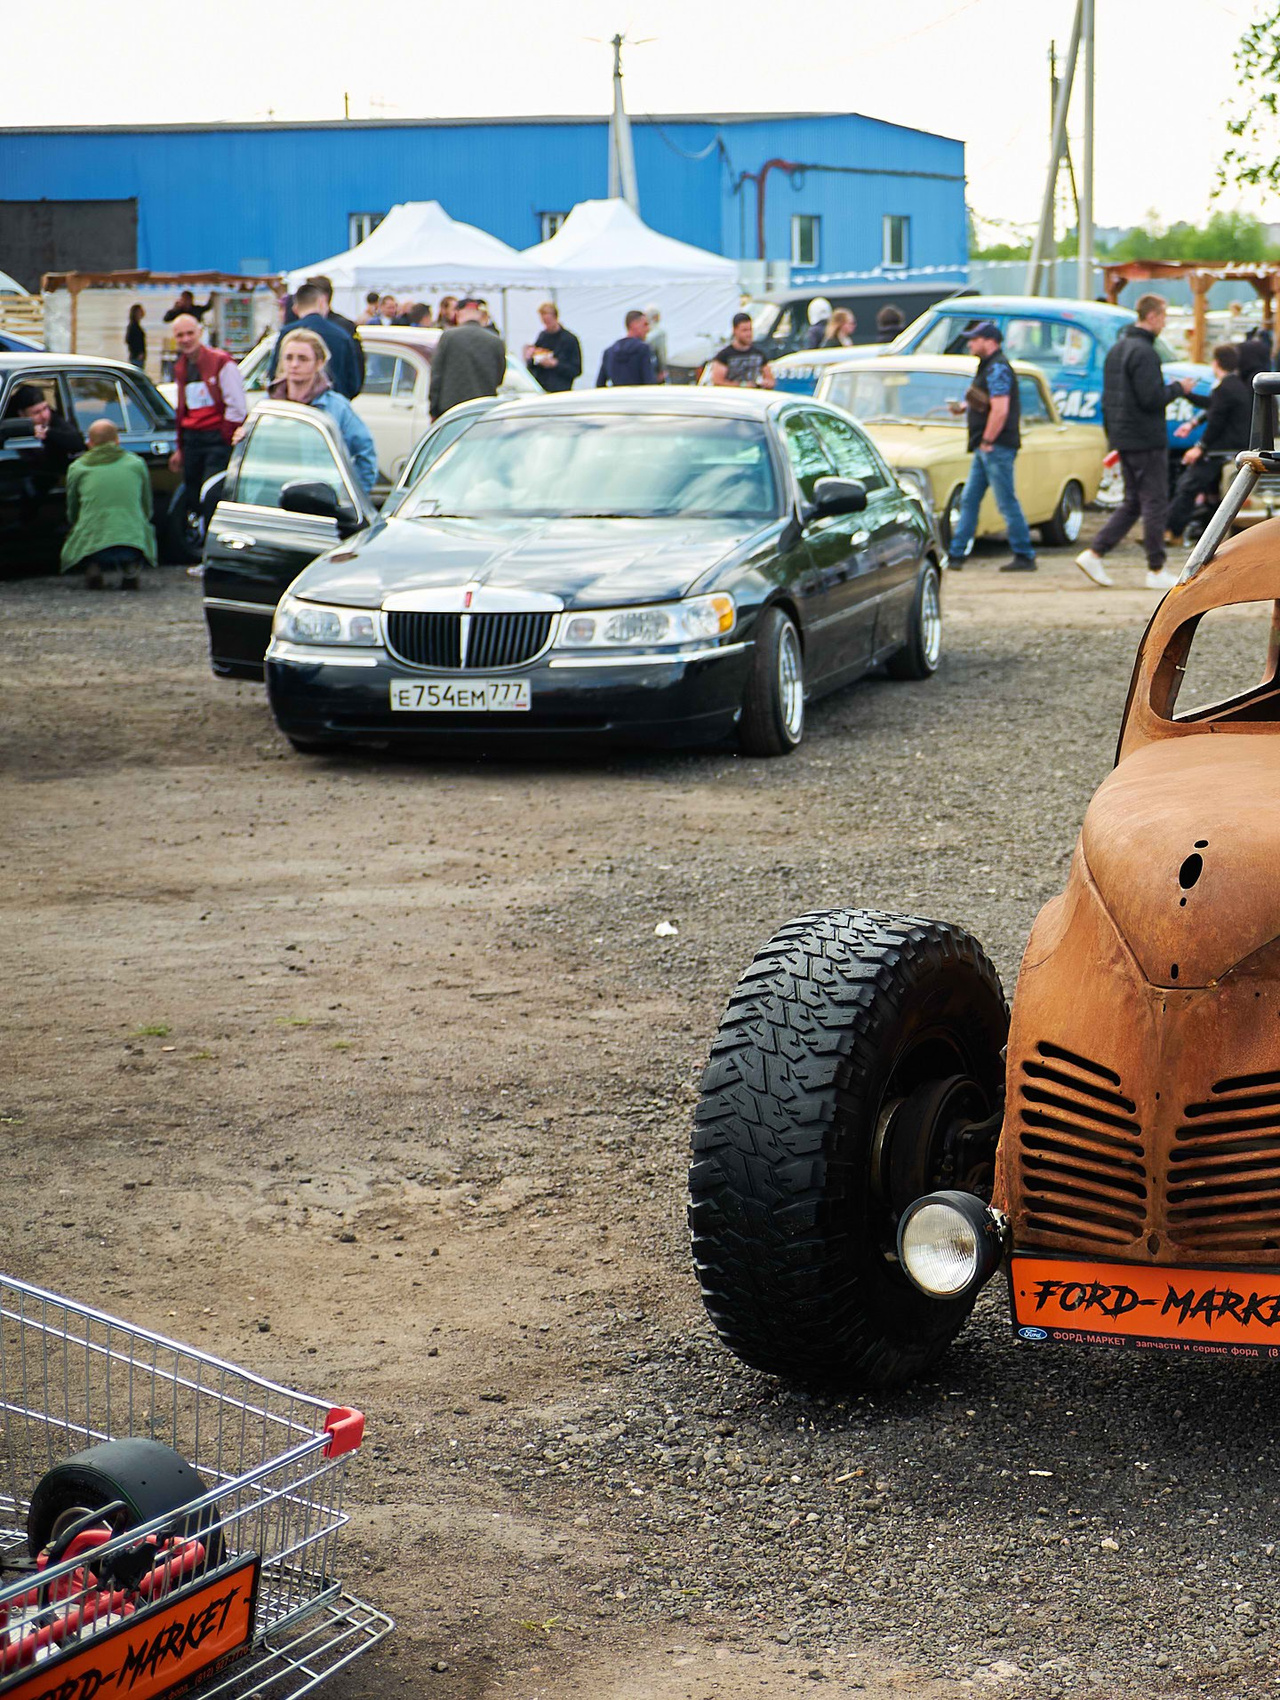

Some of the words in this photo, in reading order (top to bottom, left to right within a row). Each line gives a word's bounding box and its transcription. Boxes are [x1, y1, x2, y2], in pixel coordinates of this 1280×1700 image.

[490, 684, 522, 700] 777
[1053, 1331, 1126, 1346] ФОРД-МАРКЕТ
[1136, 1340, 1181, 1350] запчасти
[1193, 1345, 1228, 1355] сервис
[1231, 1346, 1259, 1357] форд
[31, 1585, 244, 1700] RD-MARKET
